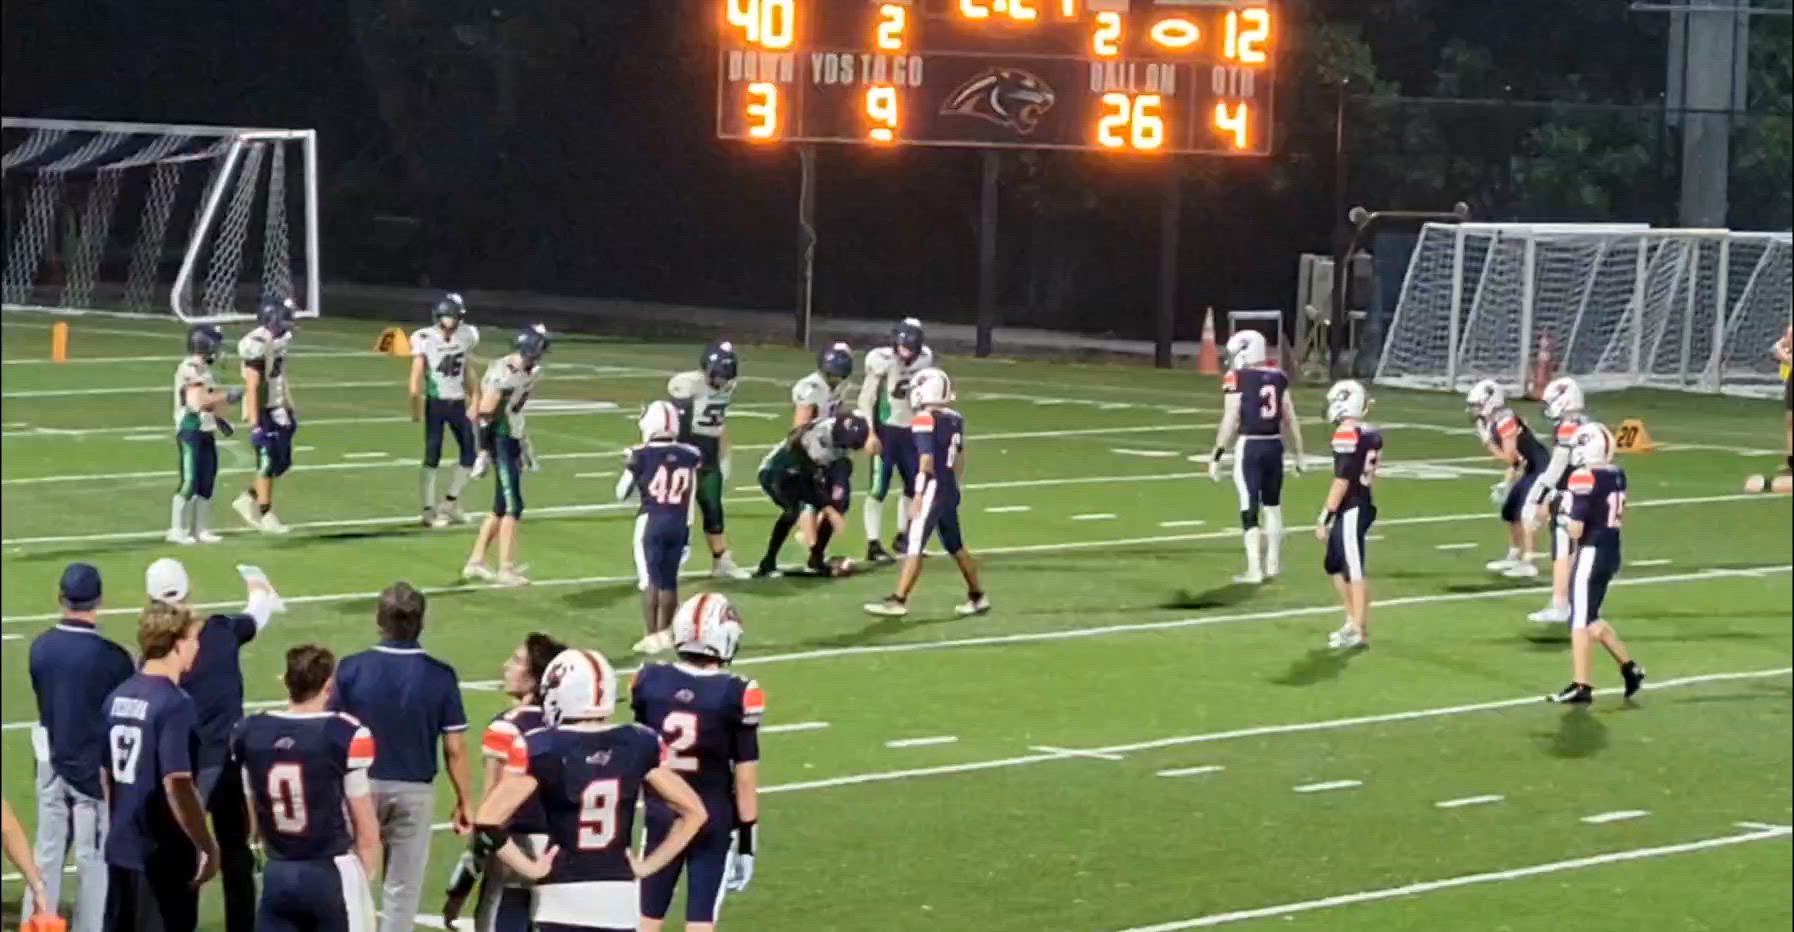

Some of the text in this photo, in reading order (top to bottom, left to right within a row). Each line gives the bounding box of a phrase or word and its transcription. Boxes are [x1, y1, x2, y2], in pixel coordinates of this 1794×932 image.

[727, 0, 795, 48] 40
[877, 4, 905, 49] 2
[1093, 11, 1121, 56] 2
[1224, 8, 1270, 63] 12
[728, 51, 795, 83] DOWN
[811, 53, 923, 87] YDS TO GO
[747, 82, 777, 138] 3
[866, 87, 897, 141] 9
[1097, 93, 1164, 148] 26
[1215, 102, 1247, 149] 4
[436, 352, 467, 378] 46
[1258, 384, 1278, 420] 3
[1616, 426, 1639, 448] 20
[648, 464, 691, 505] 40
[663, 711, 700, 771] 2
[577, 777, 621, 849] 9
